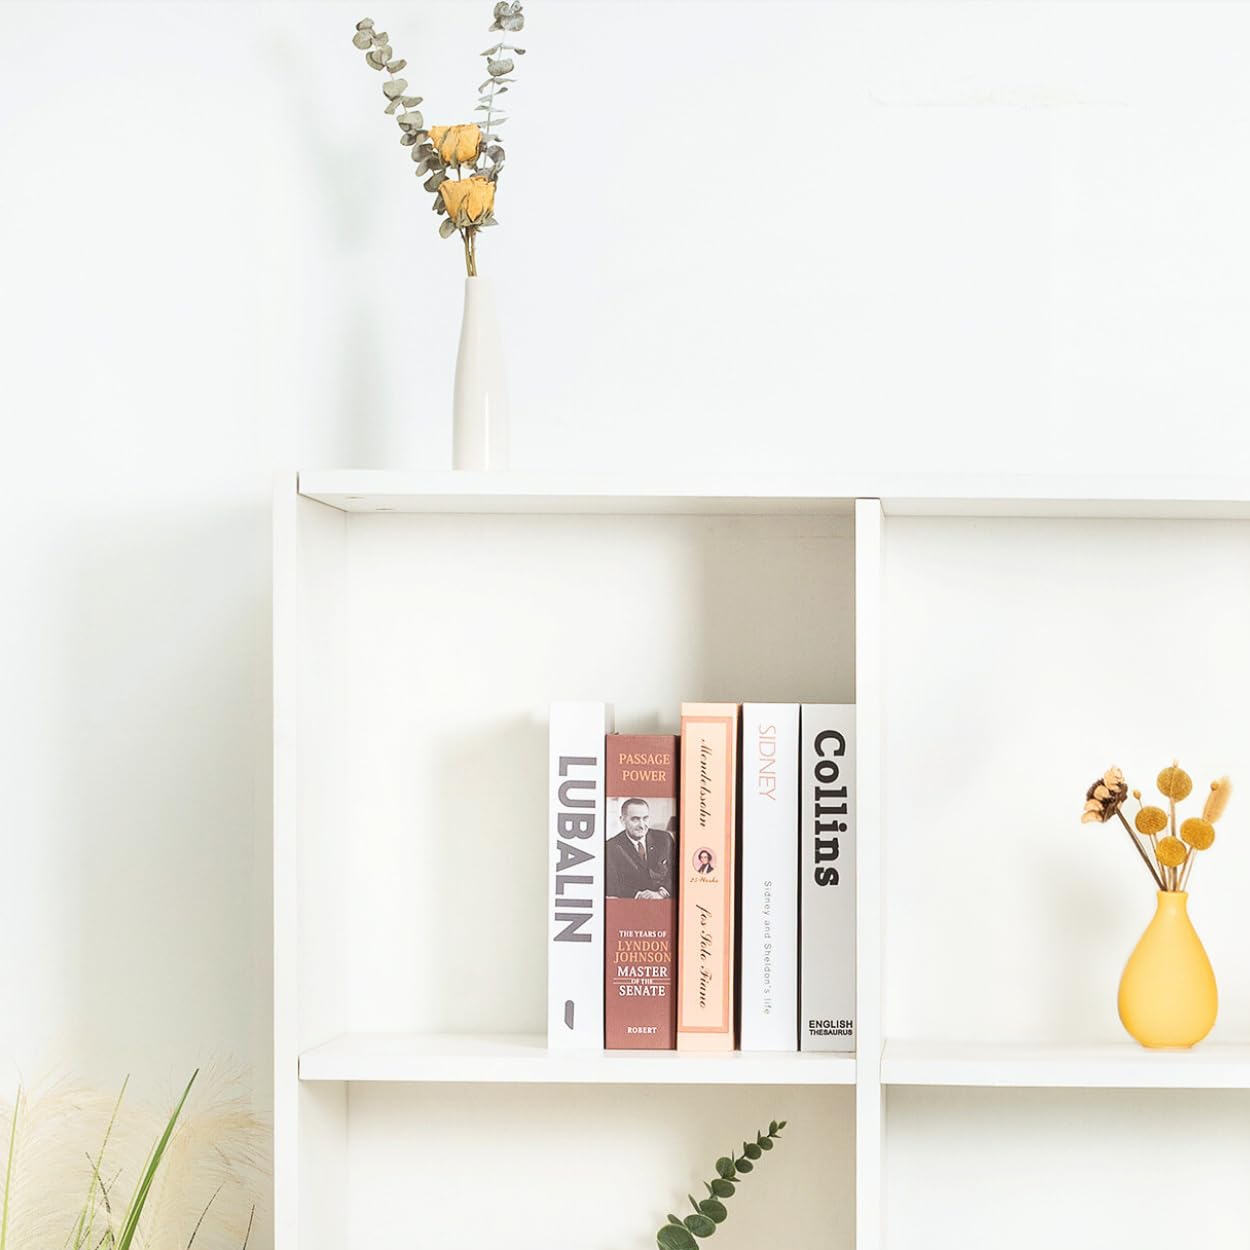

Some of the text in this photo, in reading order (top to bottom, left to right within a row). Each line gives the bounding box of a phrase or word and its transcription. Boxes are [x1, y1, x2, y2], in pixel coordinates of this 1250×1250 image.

[619, 753, 671, 765] PASSAGE
[758, 725, 776, 801] SIDNEY
[622, 770, 666, 781] POWER
[700, 738, 712, 828] Mendelssohn
[814, 730, 848, 887] Collins
[553, 756, 597, 943] LUBALIN
[618, 940, 668, 952] LYNDON
[762, 880, 772, 1015] Sidney and Sheldon's life
[614, 952, 672, 963] JOHNSON
[617, 966, 667, 977] MASTER
[619, 985, 666, 996] SENATE
[809, 1020, 853, 1028] ENGLISH
